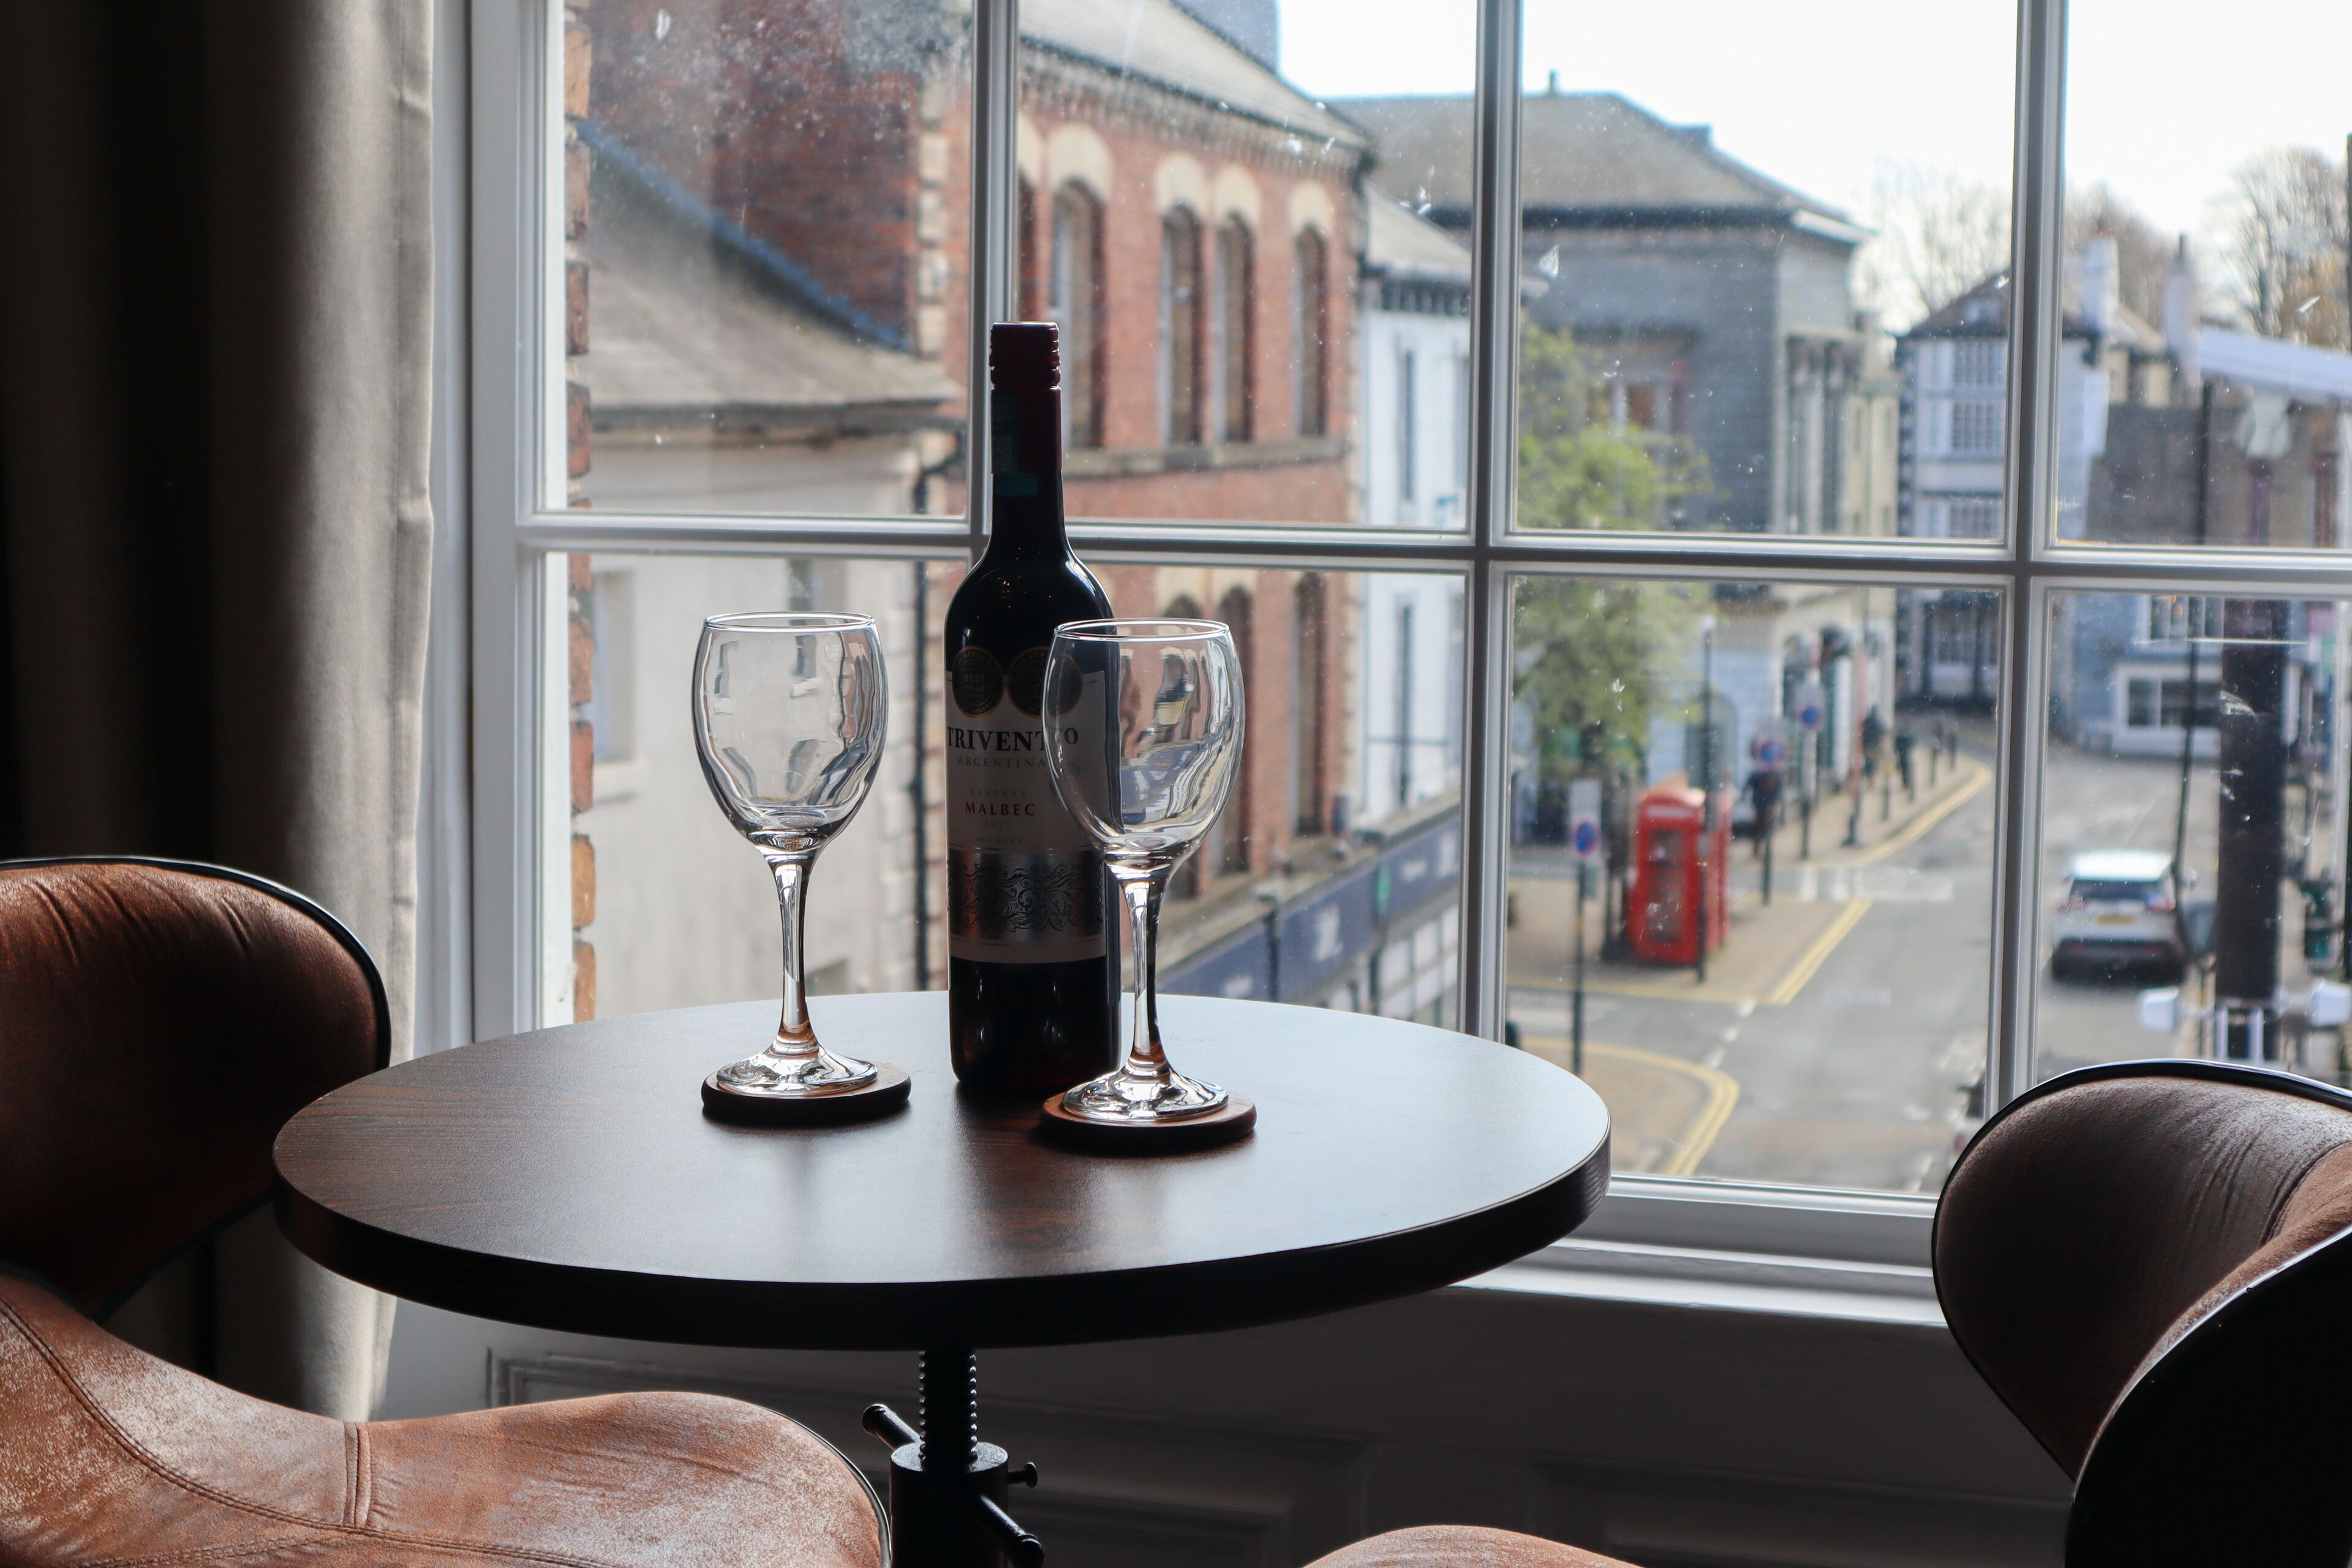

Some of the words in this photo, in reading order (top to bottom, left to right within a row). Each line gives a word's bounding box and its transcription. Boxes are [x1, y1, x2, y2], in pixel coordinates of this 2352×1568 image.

[963, 673, 986, 683] BEST
[963, 684, 986, 692] VALUE
[957, 755, 1047, 767] ARGENTINA
[970, 788, 1028, 797] RESERVE
[965, 801, 1035, 816] MALBEC
[975, 836, 1023, 845] MENDOZA
